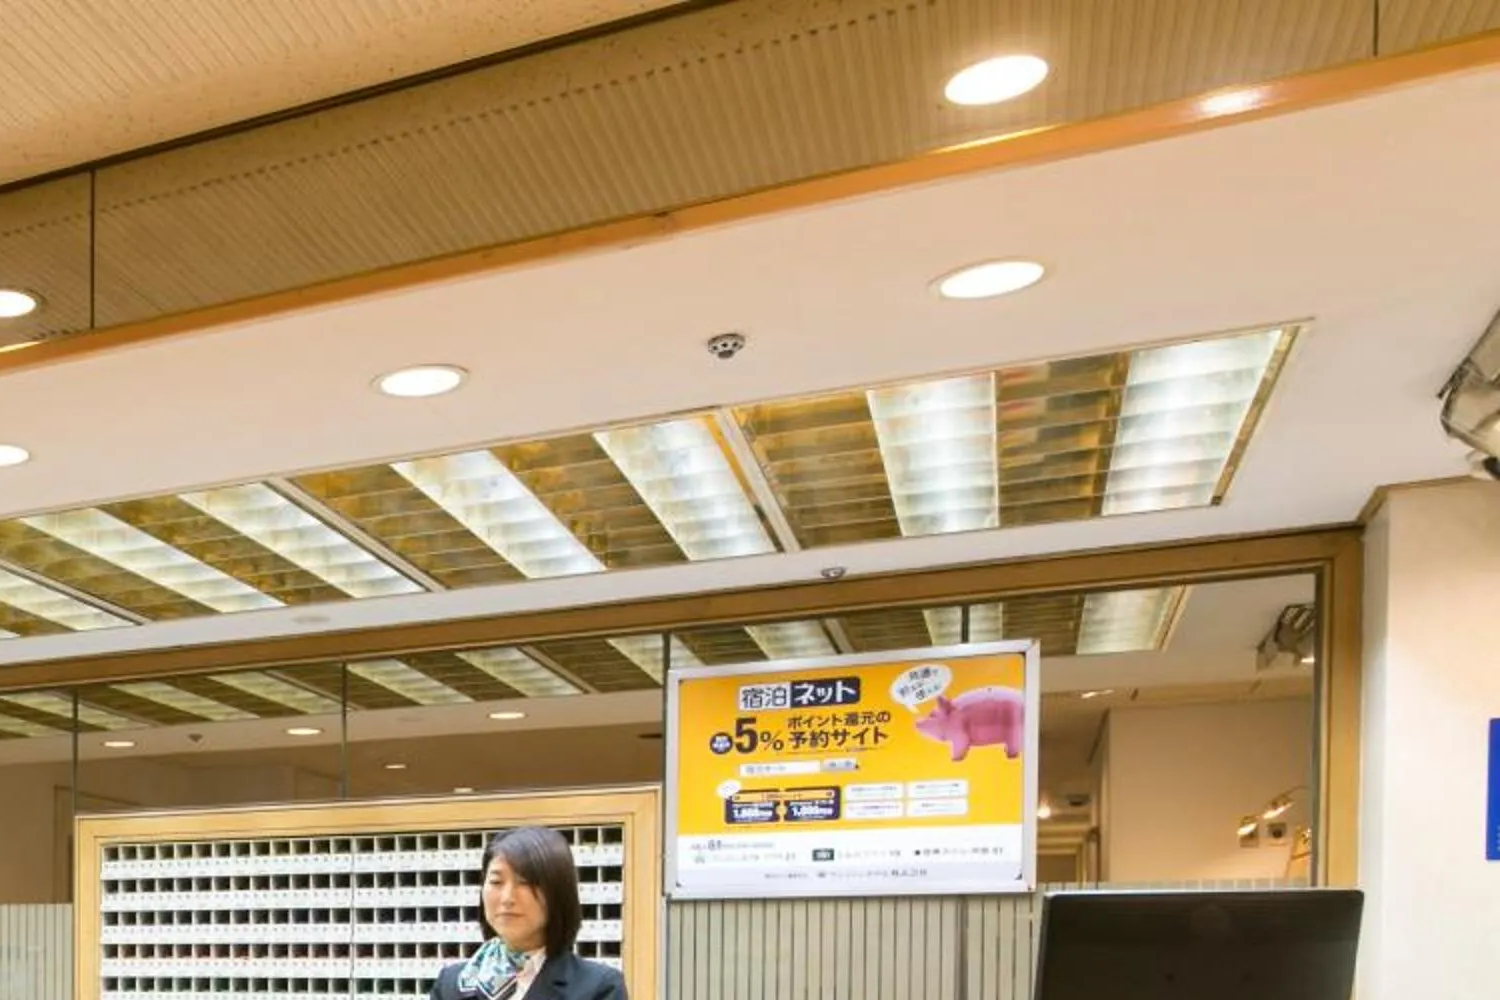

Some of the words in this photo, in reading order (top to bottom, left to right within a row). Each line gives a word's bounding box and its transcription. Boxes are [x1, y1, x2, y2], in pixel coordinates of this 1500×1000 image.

[742, 681, 856, 708] 宿泊ネット
[787, 711, 891, 729] ポイント還元の
[735, 718, 784, 753] 5%
[788, 727, 888, 750] 予約サイト
